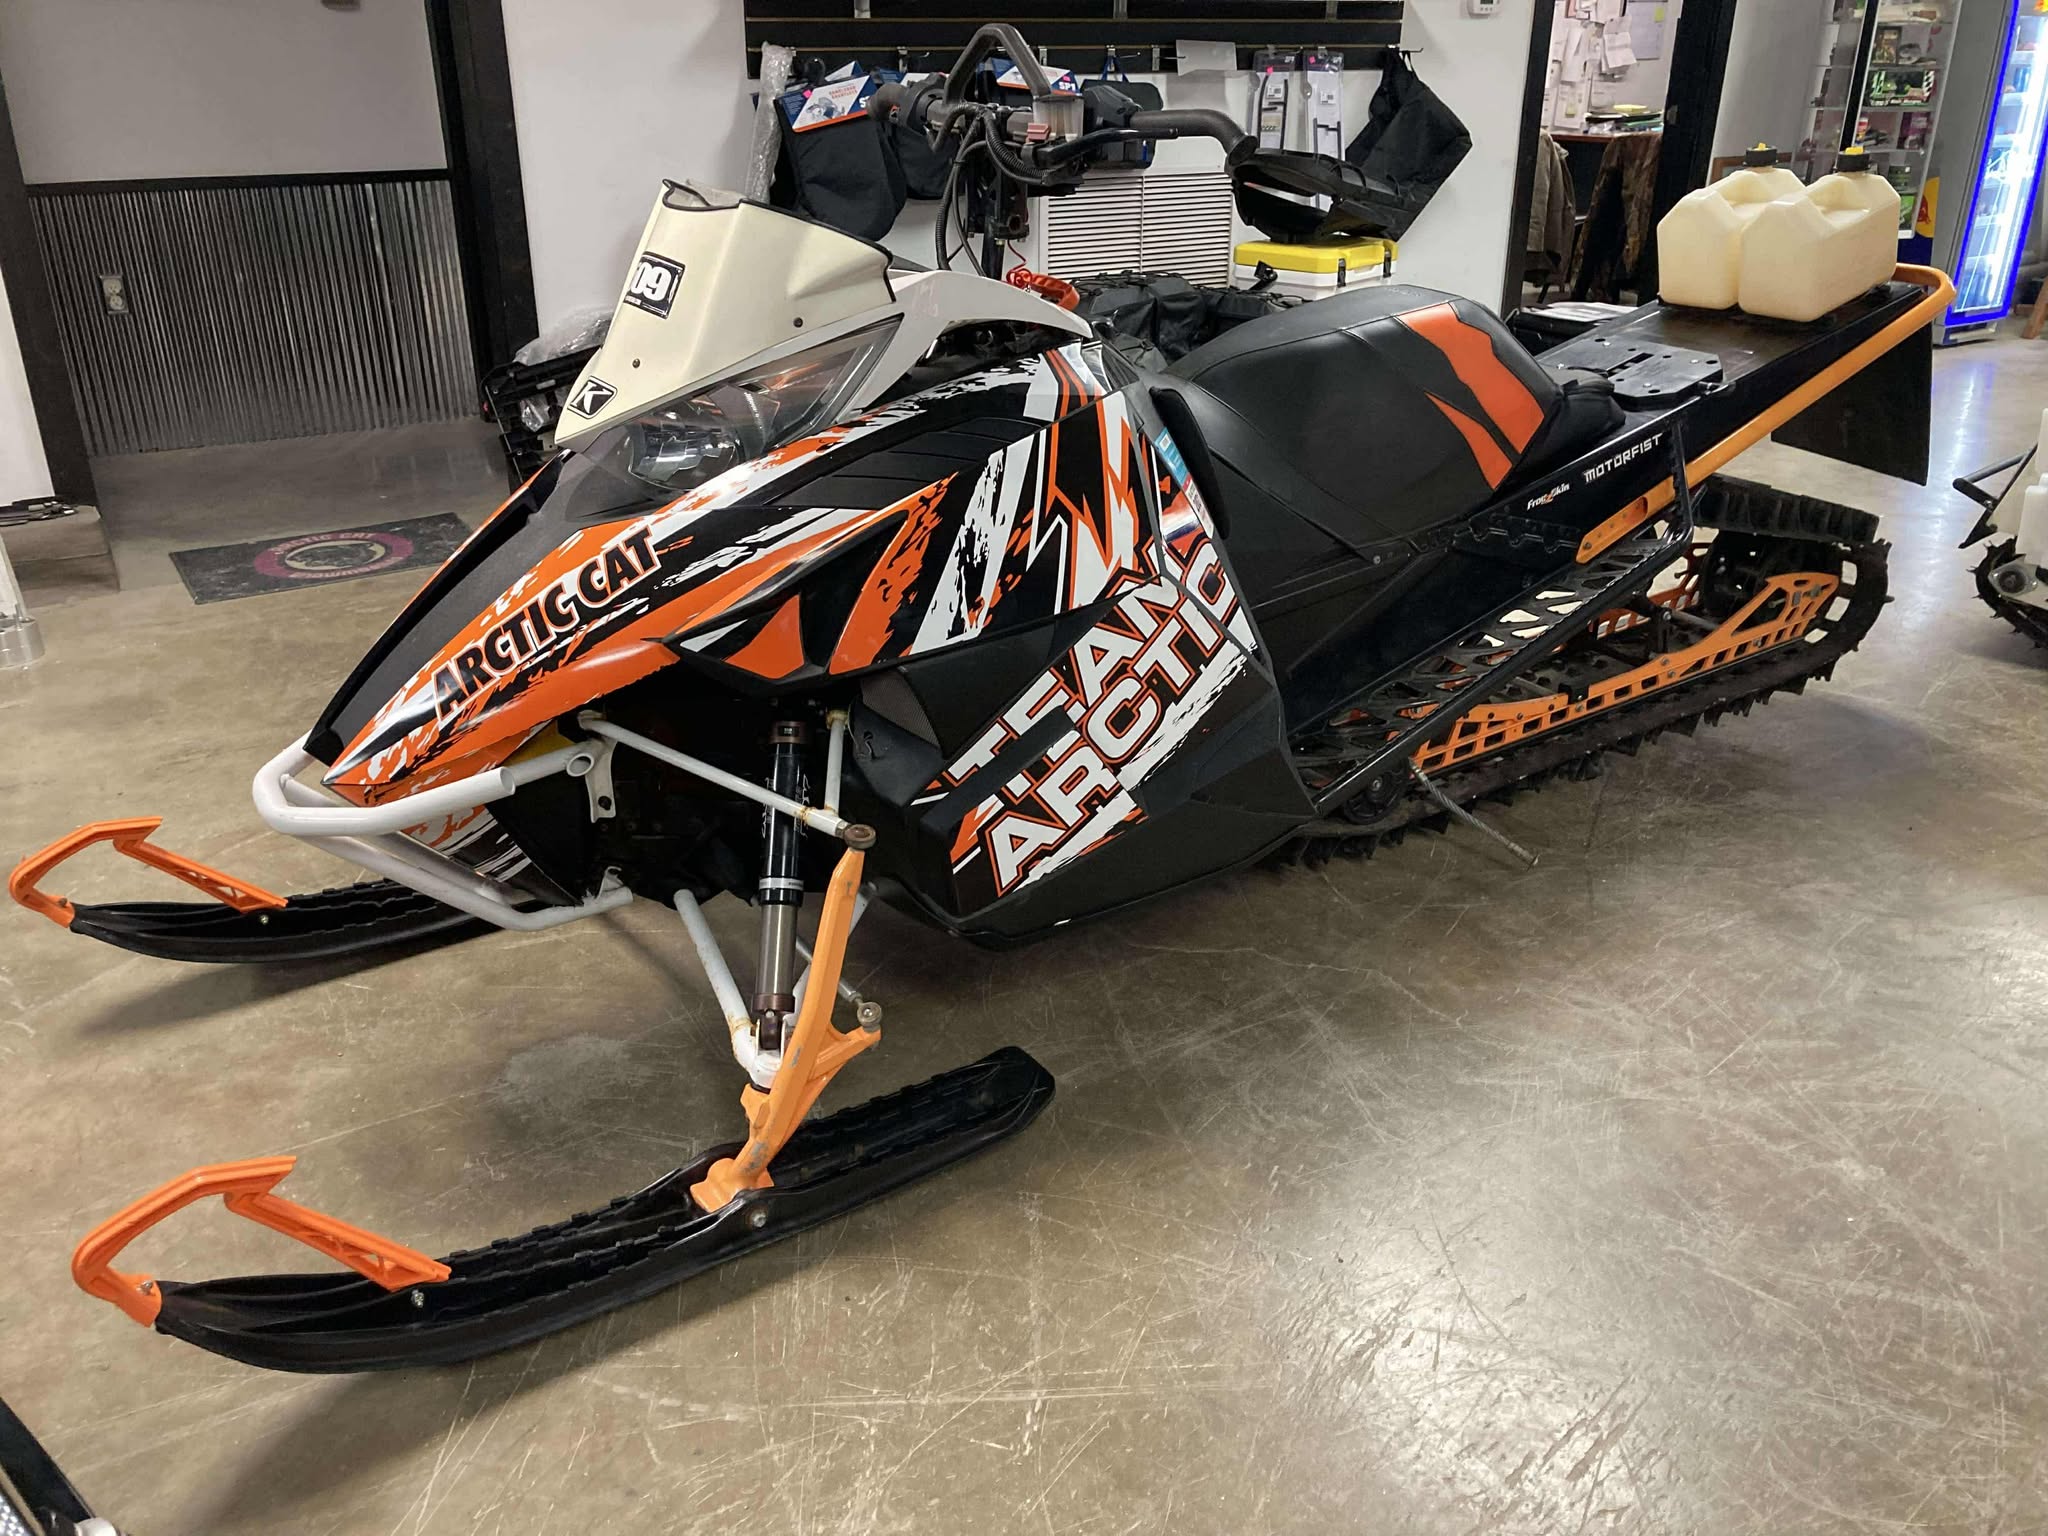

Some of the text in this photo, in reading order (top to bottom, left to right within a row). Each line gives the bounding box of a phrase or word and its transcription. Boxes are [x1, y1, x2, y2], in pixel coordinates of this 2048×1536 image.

[630, 261, 672, 301] 09
[1583, 432, 1663, 483] MOTORFIST
[433, 525, 661, 729] ARCTIC CAT
[947, 540, 1184, 798] TEAM
[988, 539, 1238, 895] ARCTIC
